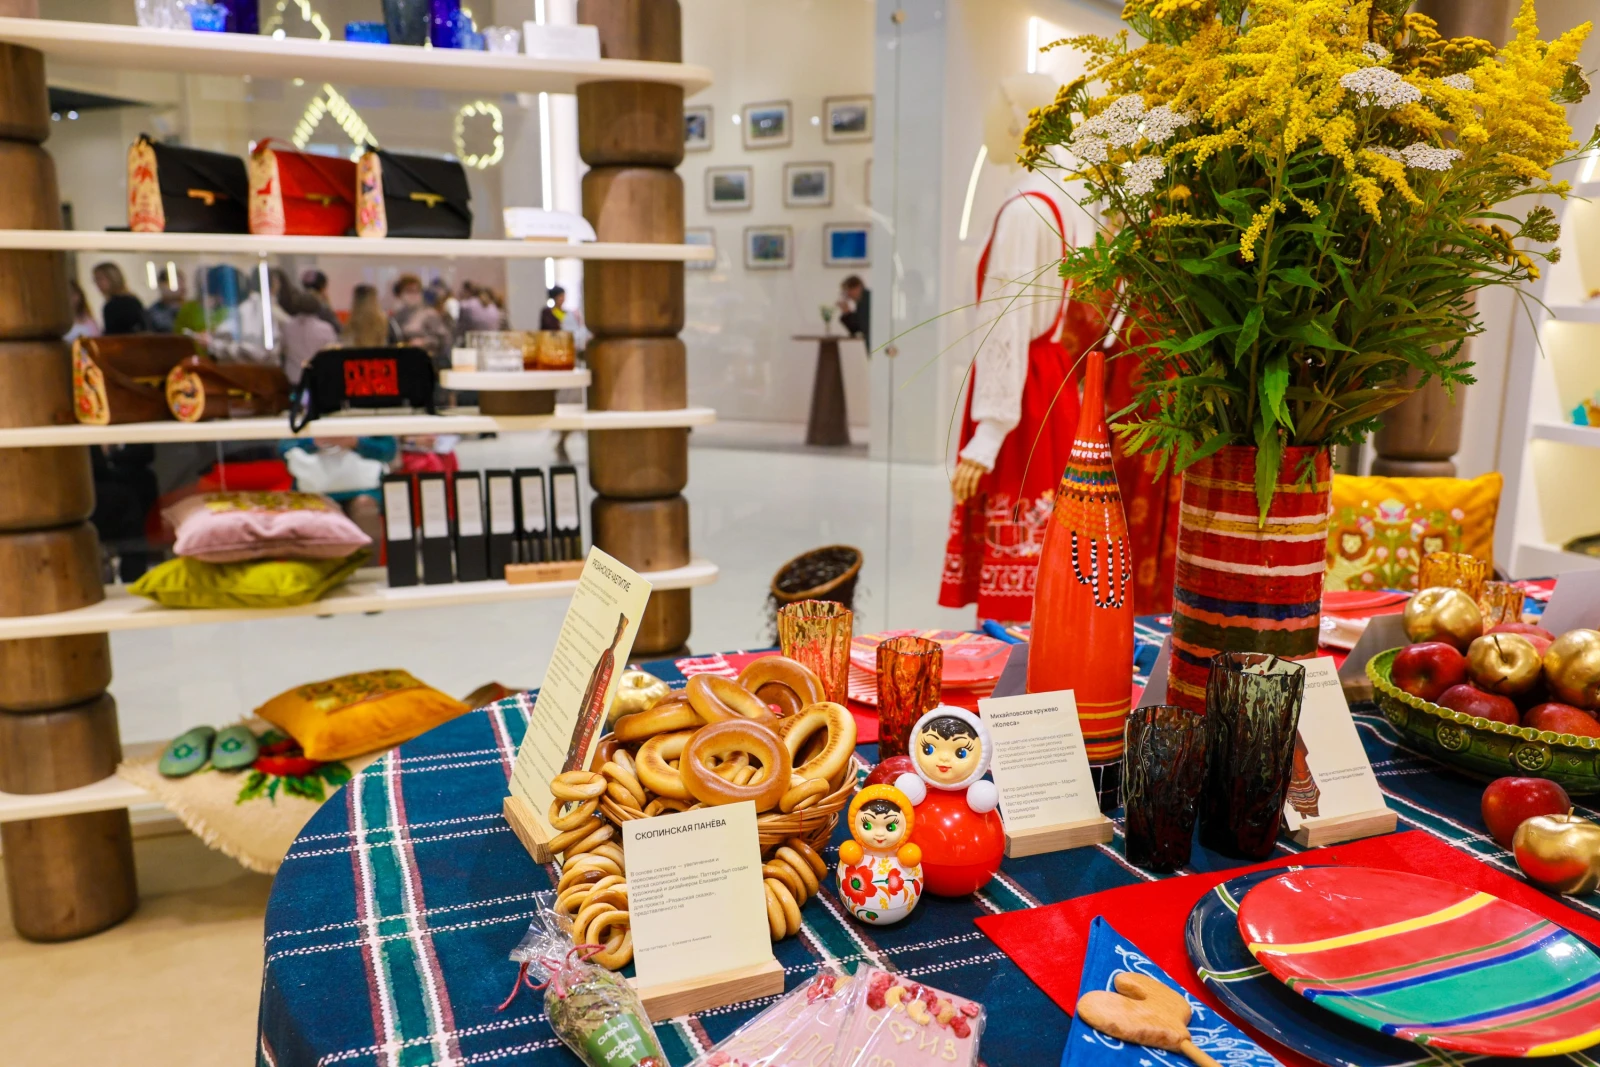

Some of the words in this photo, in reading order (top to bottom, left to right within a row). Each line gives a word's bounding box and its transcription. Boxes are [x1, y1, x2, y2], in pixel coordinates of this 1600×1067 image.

[592, 558, 613, 579] РЯЗАНСКОЕ
[611, 572, 632, 593] ЧАЕПИТИЕ
[1321, 679, 1339, 688] уезда
[990, 710, 1033, 719] Михайловское
[1034, 706, 1058, 715] кружево
[1007, 806, 1039, 814] Владимировна
[635, 824, 693, 841] СКОПИНСКАЯ
[694, 819, 726, 831] ПАНЁВА
[654, 865, 676, 873] скатерти
[684, 858, 715, 868] увеличенная
[631, 872, 675, 883] переосмысленная
[650, 877, 679, 887] скопинской
[632, 887, 663, 897] художницей
[668, 881, 698, 891] дизайнером
[699, 875, 727, 884] Елизаветой
[633, 894, 663, 903] Анисимовой
[634, 905, 677, 917] представленного
